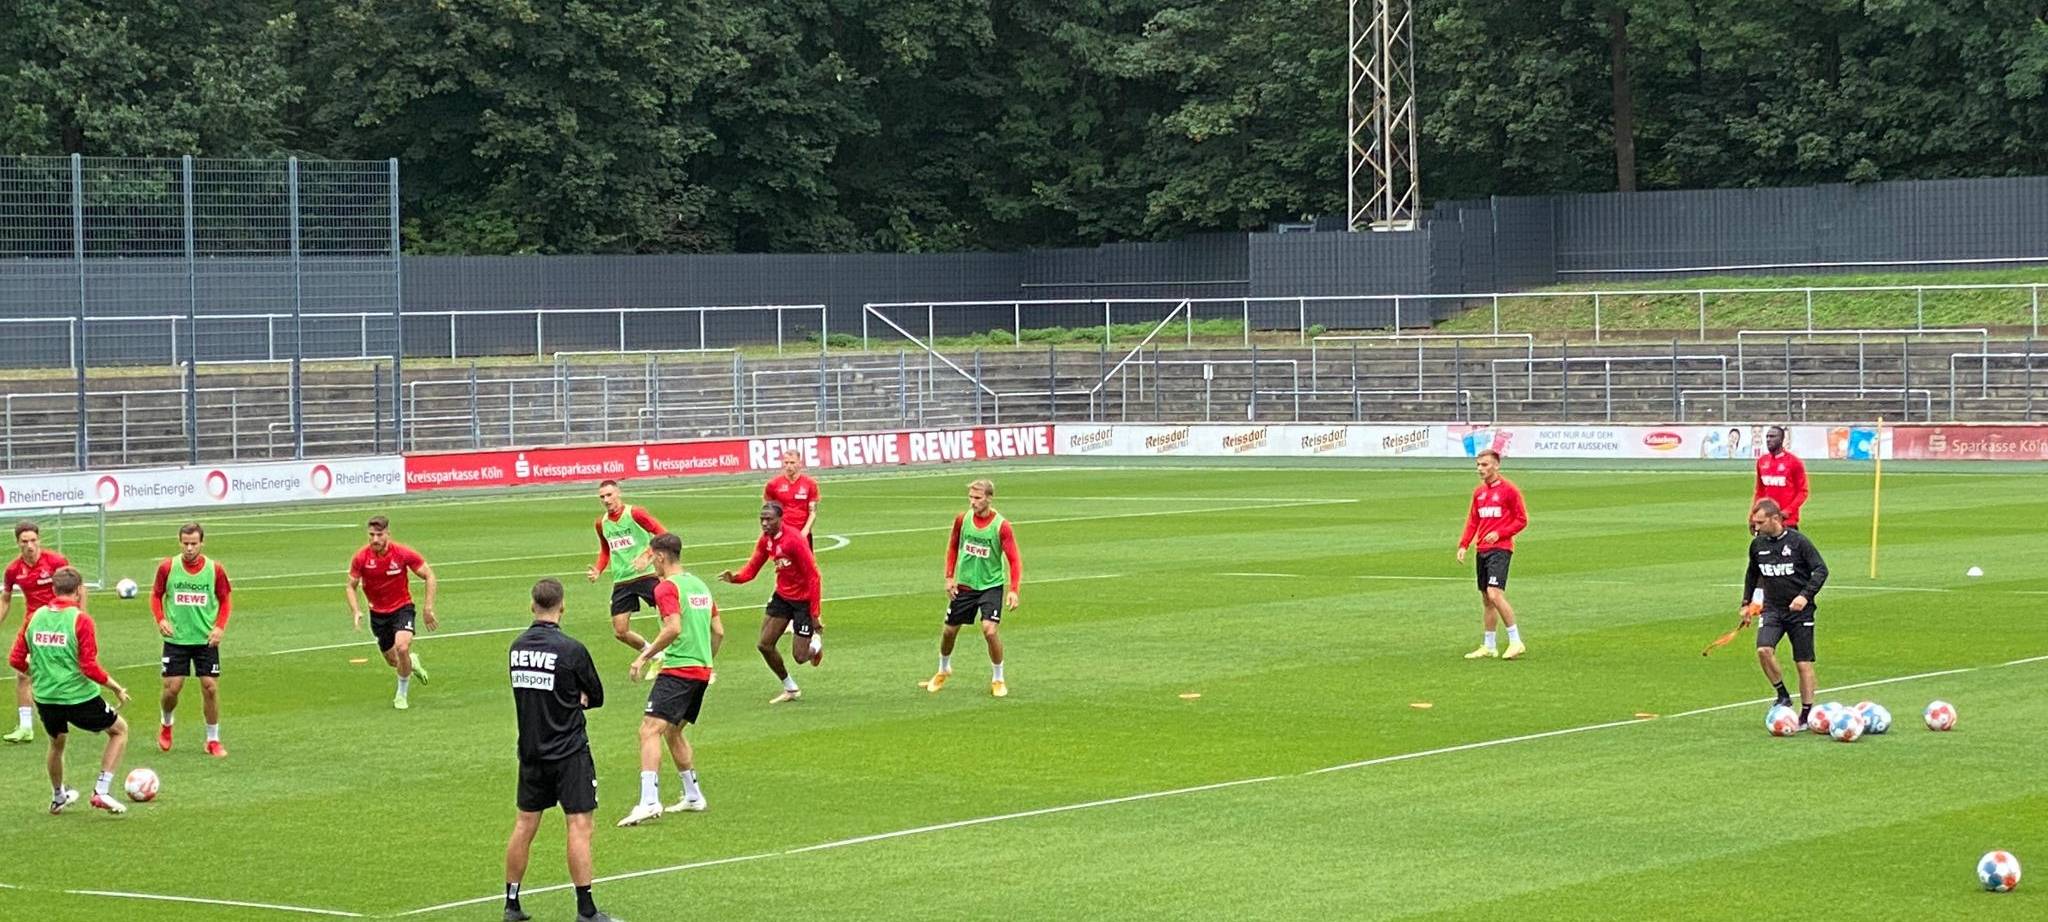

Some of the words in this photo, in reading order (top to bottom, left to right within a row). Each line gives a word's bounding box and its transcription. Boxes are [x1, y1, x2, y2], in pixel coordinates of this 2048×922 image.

[986, 427, 1047, 456] REWE
[1070, 425, 1114, 448] Reissdorf
[1145, 425, 1190, 448] Reissdorf
[1222, 425, 1268, 448] Reissdorf
[1301, 425, 1348, 449] Reissdorf
[1382, 425, 1430, 449] Reissdorf
[1539, 431, 1561, 439] NICHT
[1563, 431, 1580, 439] NUR
[1581, 431, 1595, 439] AUF
[1597, 431, 1613, 439] DEM
[831, 434, 899, 464] REWE
[910, 431, 975, 461] REWE
[1534, 442, 1558, 450] PLATZ
[1560, 442, 1575, 450] GUT
[1577, 442, 1618, 450] AUSSEHEN
[1952, 439, 2017, 455] Sparkasse
[2020, 438, 2048, 453] Köln
[533, 464, 602, 478] Kreissparkasse
[603, 460, 625, 473] Köln
[653, 457, 718, 471] Kreissparkasse
[719, 454, 740, 467] Köln
[336, 471, 401, 487] RheinEnergie
[407, 469, 480, 484] Kreissparkasse
[481, 466, 504, 479] Köln
[123, 482, 195, 498] RheinEnergie
[232, 477, 300, 492] RheinEnergie
[9, 488, 84, 504] RheinEnergie
[177, 594, 206, 604] REWE
[34, 632, 65, 645] REWE
[510, 650, 558, 671] REWE
